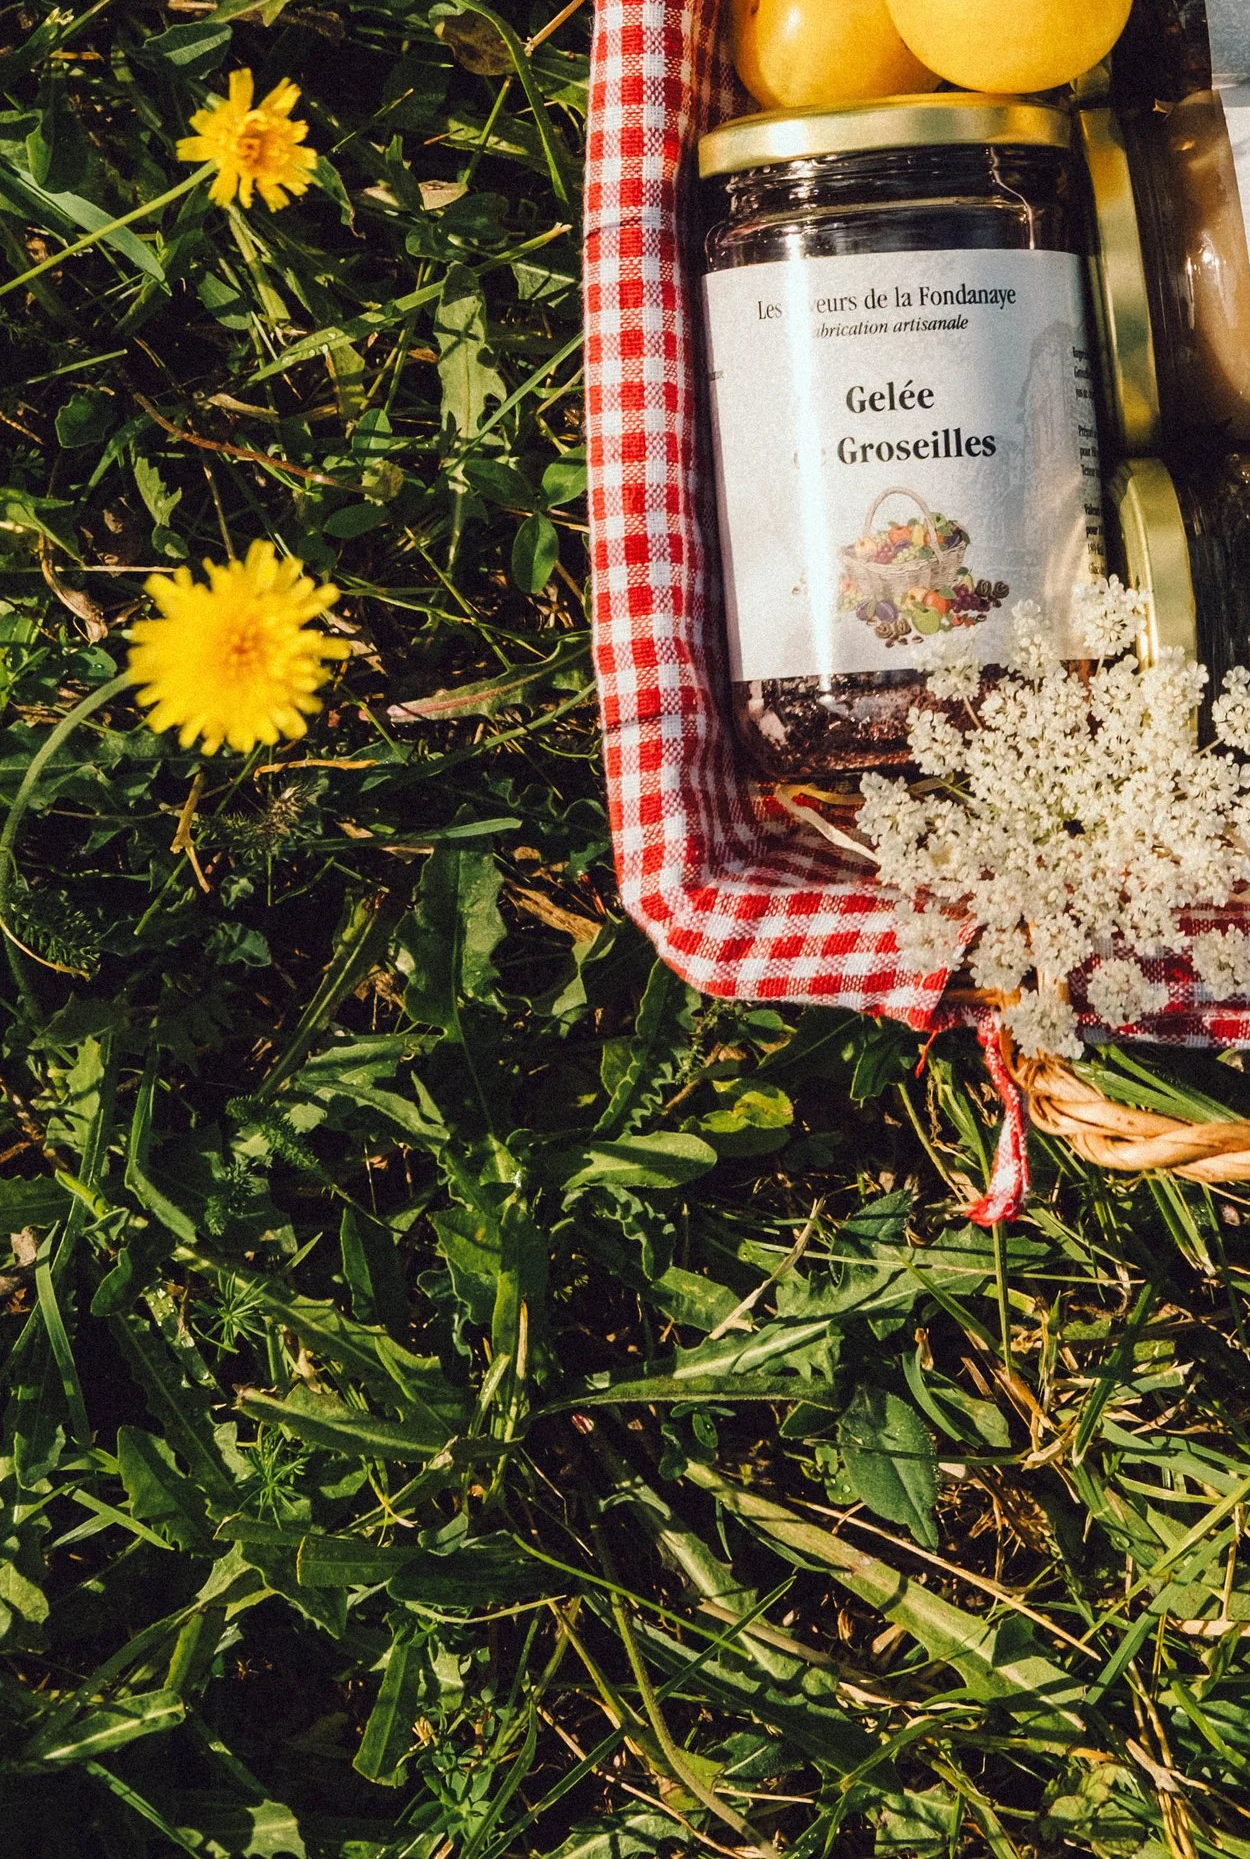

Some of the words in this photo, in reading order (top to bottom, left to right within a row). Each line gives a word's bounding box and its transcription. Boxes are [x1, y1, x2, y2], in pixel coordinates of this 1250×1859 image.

[757, 300, 783, 321] Les
[864, 288, 888, 311] de
[895, 287, 912, 308] la
[919, 283, 1017, 310] Fondanaye
[893, 314, 969, 334] artisanale
[846, 379, 935, 414] Gelée
[837, 427, 997, 465] Groseilles
